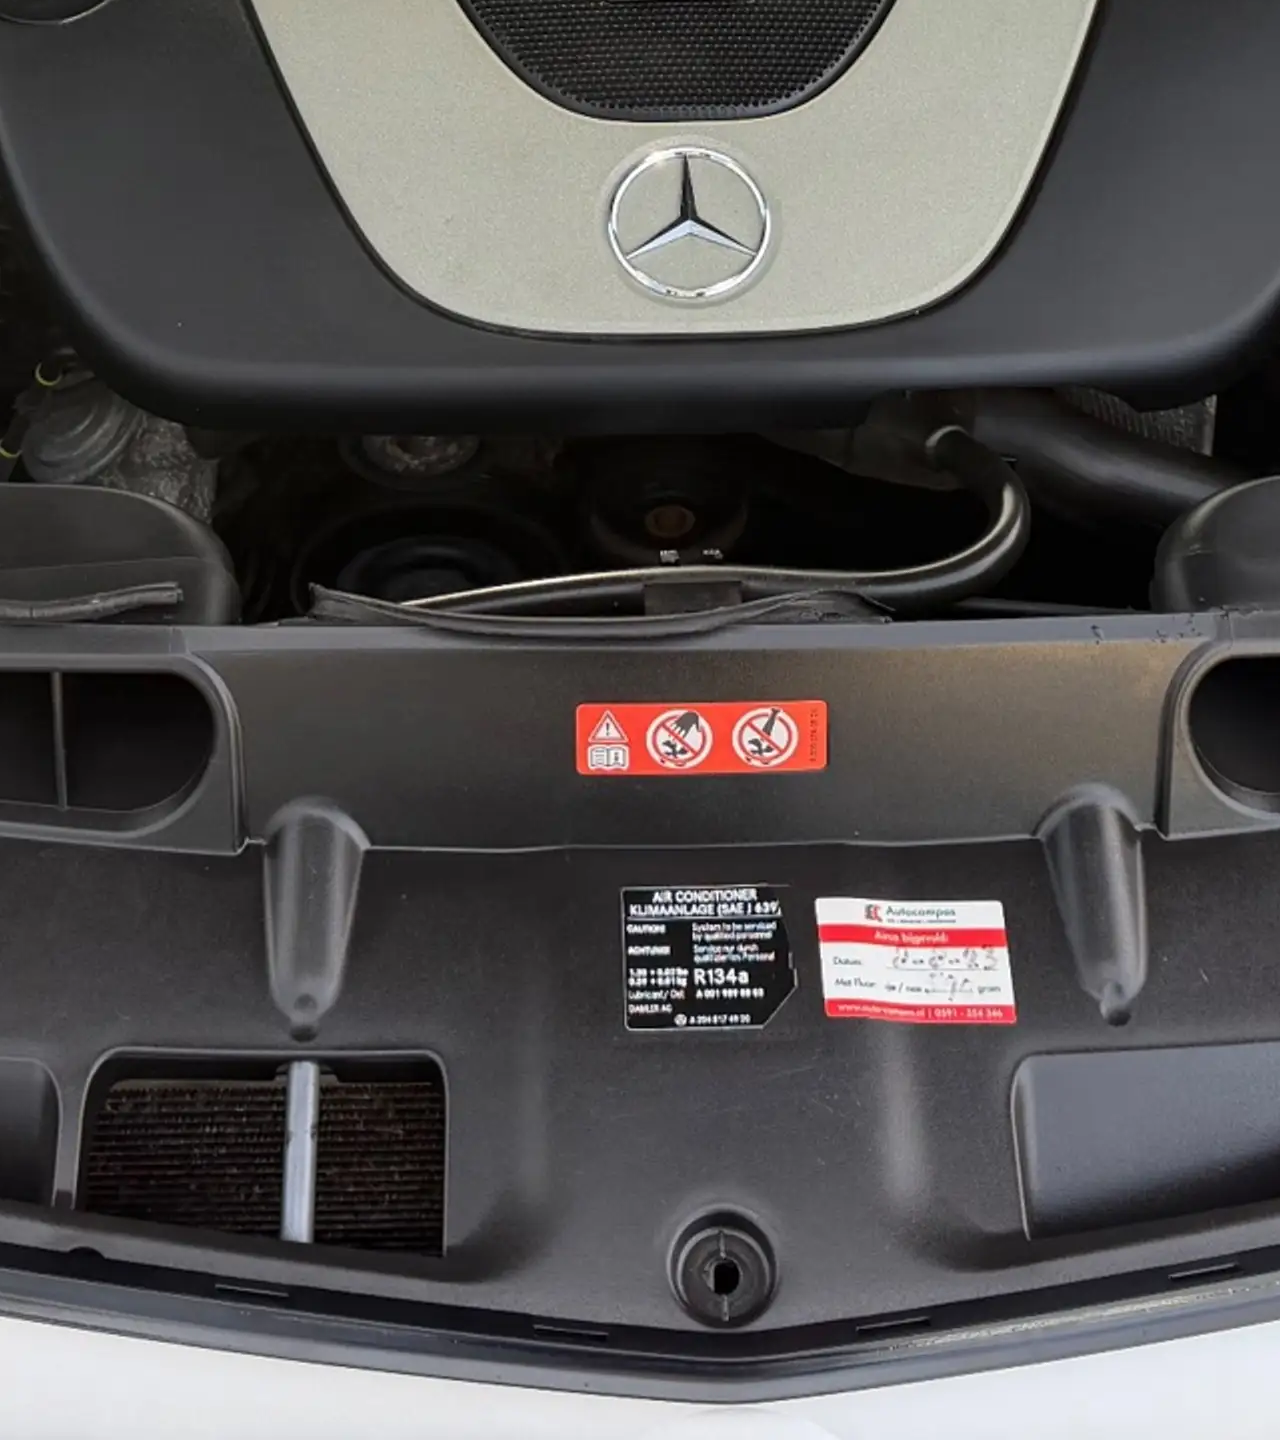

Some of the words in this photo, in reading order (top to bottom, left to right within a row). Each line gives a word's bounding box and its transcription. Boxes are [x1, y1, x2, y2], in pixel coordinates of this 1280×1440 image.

[652, 890, 673, 903] AIR
[675, 888, 758, 903] CONDITIONER
[629, 903, 715, 917] KLIMAANLAGE
[885, 905, 957, 920] Autocompas
[693, 967, 750, 986] R134a
